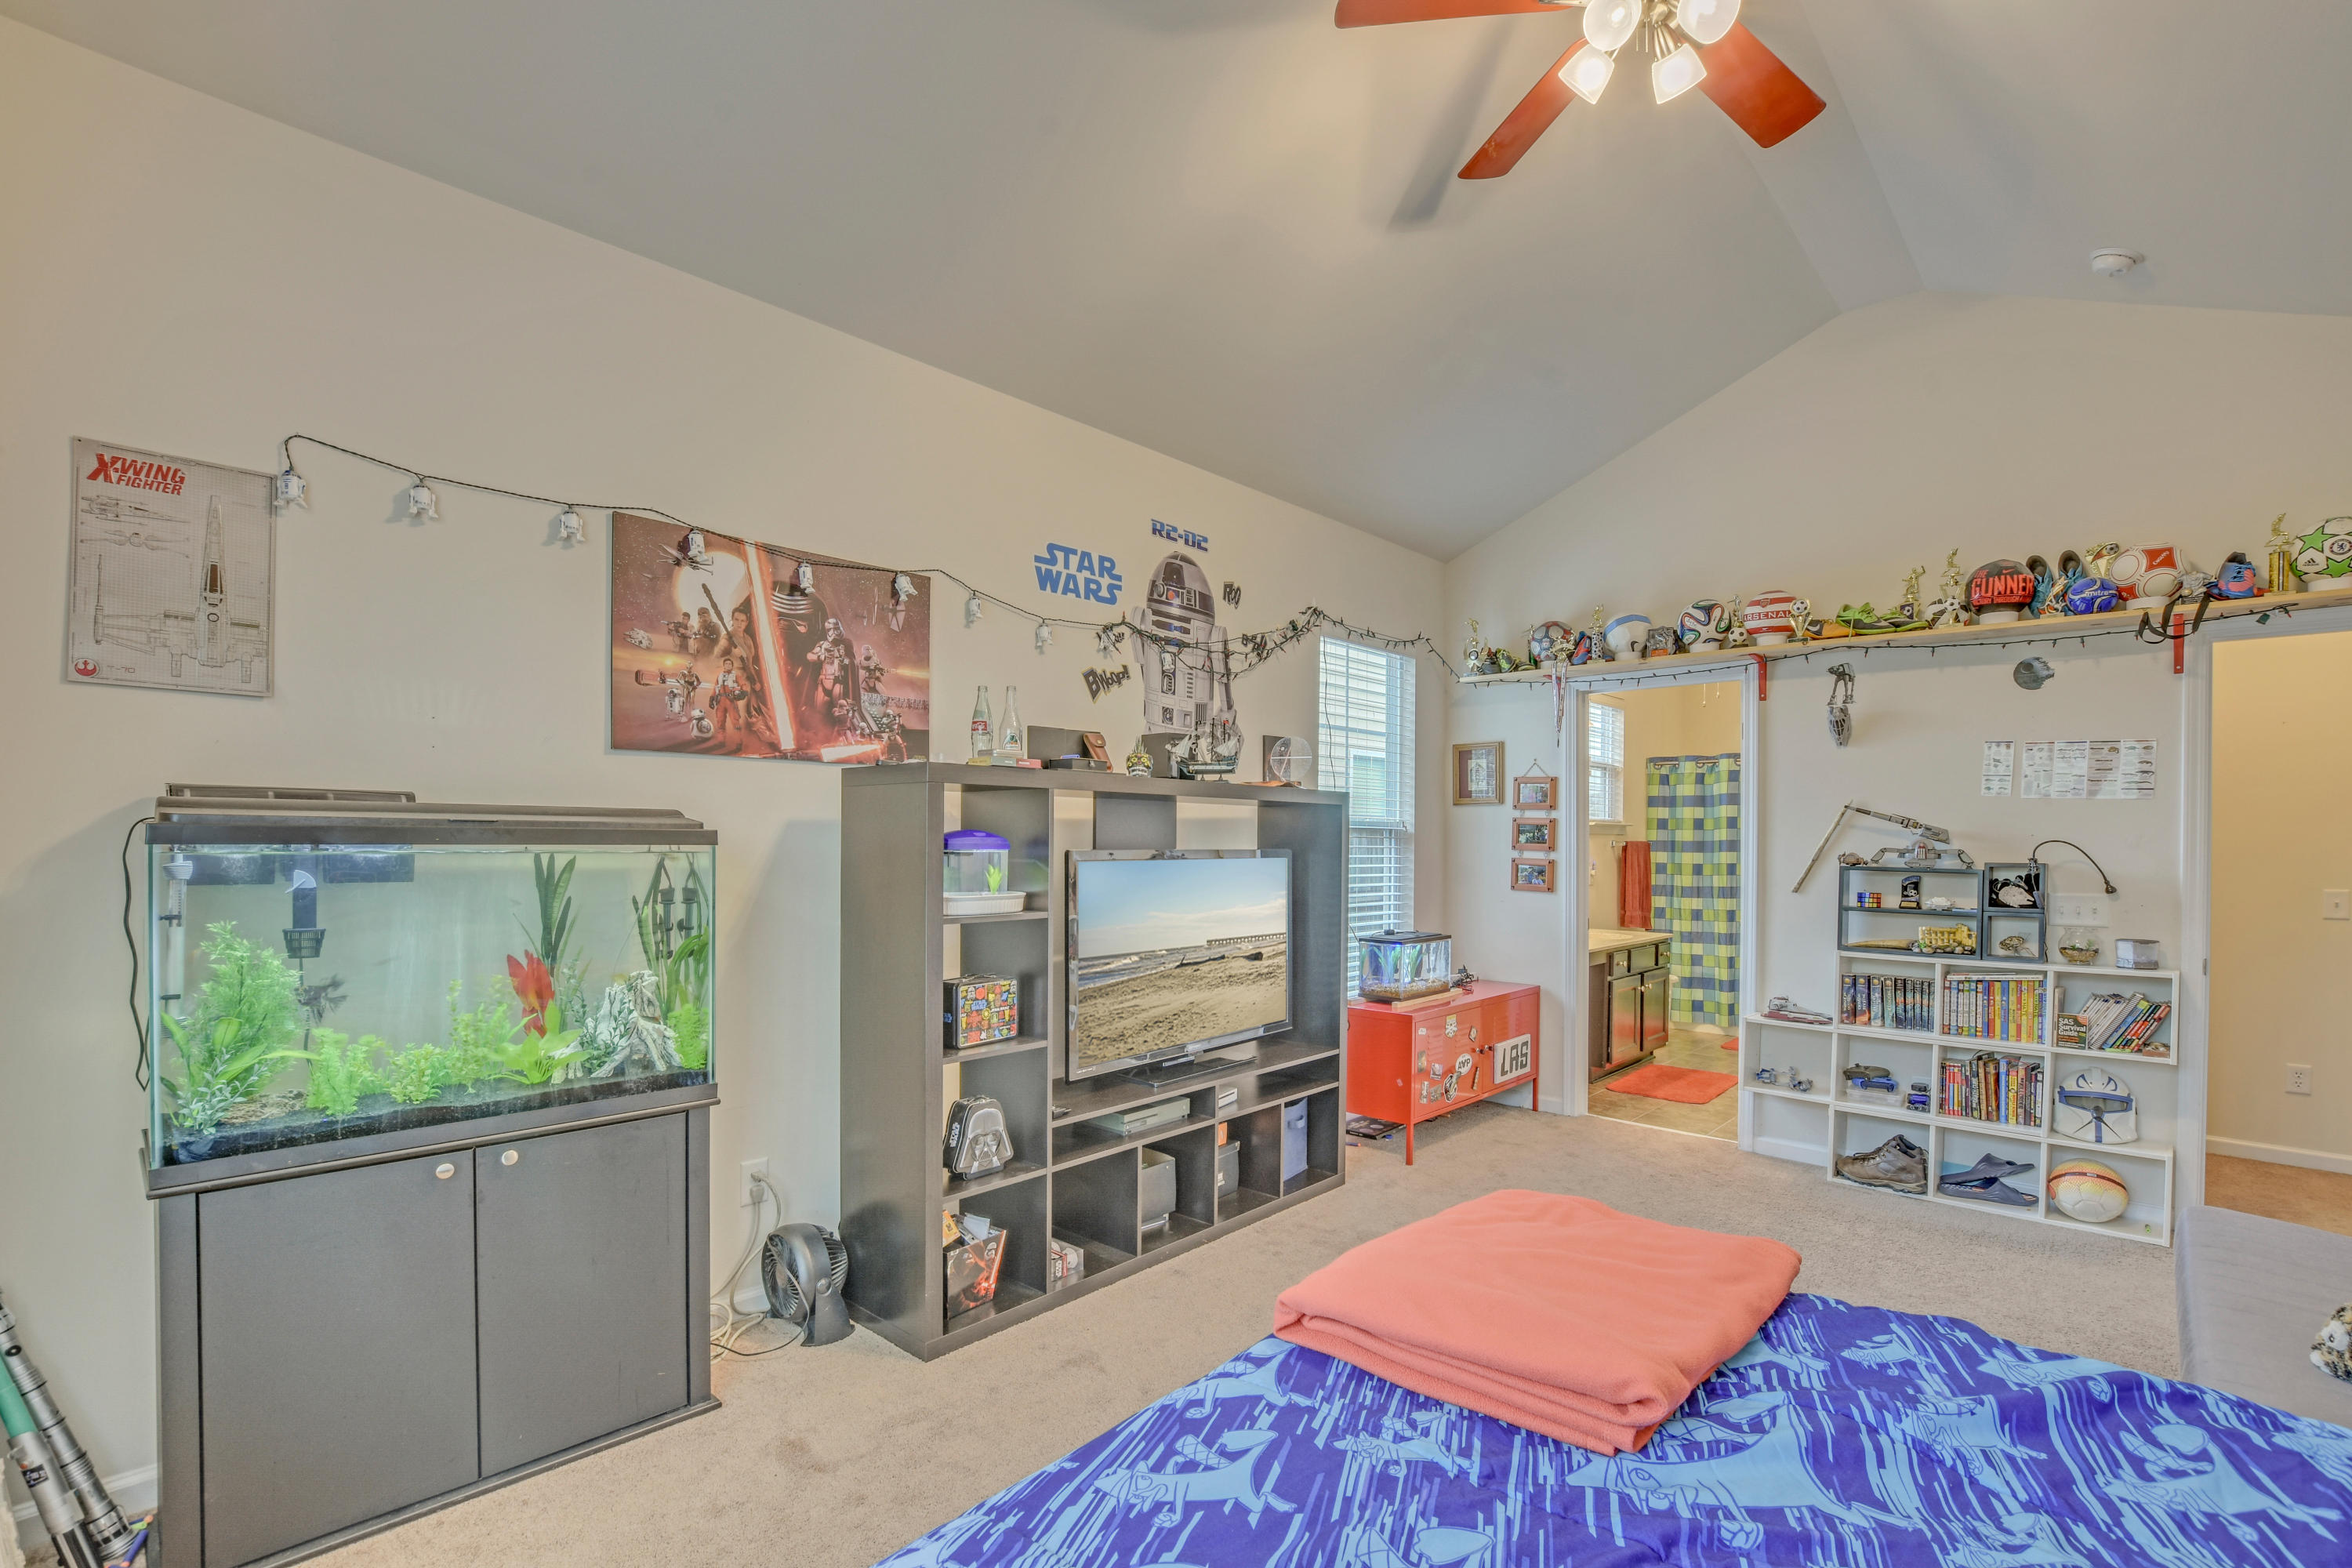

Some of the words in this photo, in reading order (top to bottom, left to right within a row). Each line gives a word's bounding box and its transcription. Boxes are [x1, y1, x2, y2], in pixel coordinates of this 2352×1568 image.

[86, 452, 186, 485] X-WING
[116, 474, 182, 495] FIGHTER
[1151, 518, 1208, 551] R2-D2
[1034, 543, 1122, 582] STAR
[1034, 565, 1122, 605] WARS
